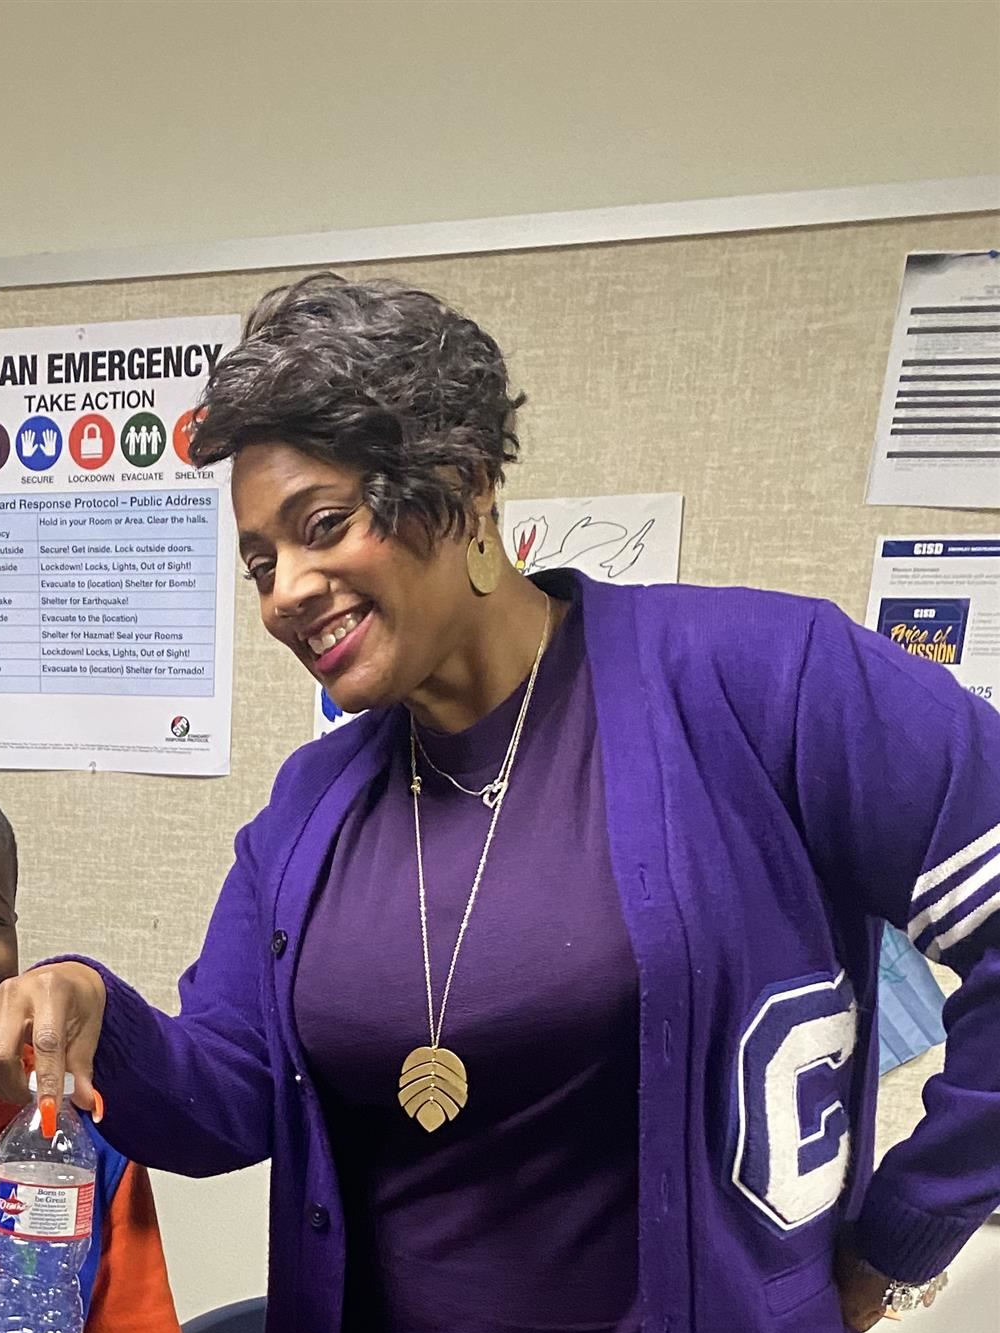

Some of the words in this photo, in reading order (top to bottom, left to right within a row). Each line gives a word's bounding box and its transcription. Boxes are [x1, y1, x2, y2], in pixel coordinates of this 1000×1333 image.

[0, 354, 38, 387] AN
[47, 343, 223, 385] EMERGENCY
[24, 393, 76, 413] TAKE
[80, 389, 155, 410] ACTION
[21, 475, 54, 485] SECURE
[68, 473, 115, 483] LOCKDOWN
[121, 471, 164, 482] EVACUATE
[175, 470, 214, 480] SHELTER
[20, 499, 71, 511] Response
[74, 496, 119, 509] Protocol
[130, 496, 162, 507] Public
[165, 495, 212, 506] Address
[40, 518, 58, 526] Hold
[60, 518, 67, 526] in
[69, 519, 86, 527] your
[89, 517, 112, 525] Room
[114, 517, 123, 525] or
[124, 516, 144, 525] Area.
[147, 516, 168, 524] Clear
[171, 515, 184, 524] the
[186, 515, 208, 524] halls.
[40, 546, 70, 554] Secure!
[71, 545, 86, 553] Get
[87, 545, 112, 553] inside.
[115, 545, 134, 553] Lock
[136, 544, 165, 552] outside
[168, 544, 194, 552] doors.
[913, 543, 944, 555] CISD
[40, 563, 83, 571] Lockdown!
[85, 562, 110, 571] Locks,
[112, 562, 138, 571] Lights,
[140, 562, 155, 570] Out
[157, 562, 166, 570] of
[168, 562, 191, 571] Sight!
[41, 580, 76, 588] Evacuate
[77, 580, 86, 588] to
[87, 580, 123, 589] (location)
[125, 580, 153, 588] Shelter
[155, 579, 166, 587] for
[169, 579, 196, 588] Bomb!
[41, 597, 68, 605] Shelter
[69, 597, 80, 605] for
[82, 597, 128, 606] Earthquake!
[42, 614, 77, 622] Evacuate
[78, 614, 86, 622] to
[88, 614, 100, 622] the
[102, 615, 138, 623] (location)
[913, 609, 936, 618] CISD
[42, 631, 68, 639] Shelter
[70, 631, 81, 639] for
[83, 631, 114, 639] Hazmat!
[135, 633, 152, 641] your
[154, 632, 183, 640] Rooms
[933, 625, 953, 643] of
[42, 648, 84, 656] Lockdown!
[86, 648, 111, 657] Locks,
[112, 649, 139, 658] Lights,
[140, 649, 155, 657] Out
[156, 649, 165, 657] of
[166, 649, 190, 658] Sight!
[42, 665, 78, 673] Evacuate
[79, 665, 87, 673] to
[89, 665, 124, 675] (location)
[125, 666, 153, 674] Shelter
[154, 666, 165, 674] for
[168, 666, 205, 675] Tornado!
[742, 980, 857, 1229] C
[34, 1195, 45, 1203] be
[45, 1196, 67, 1204] Great
